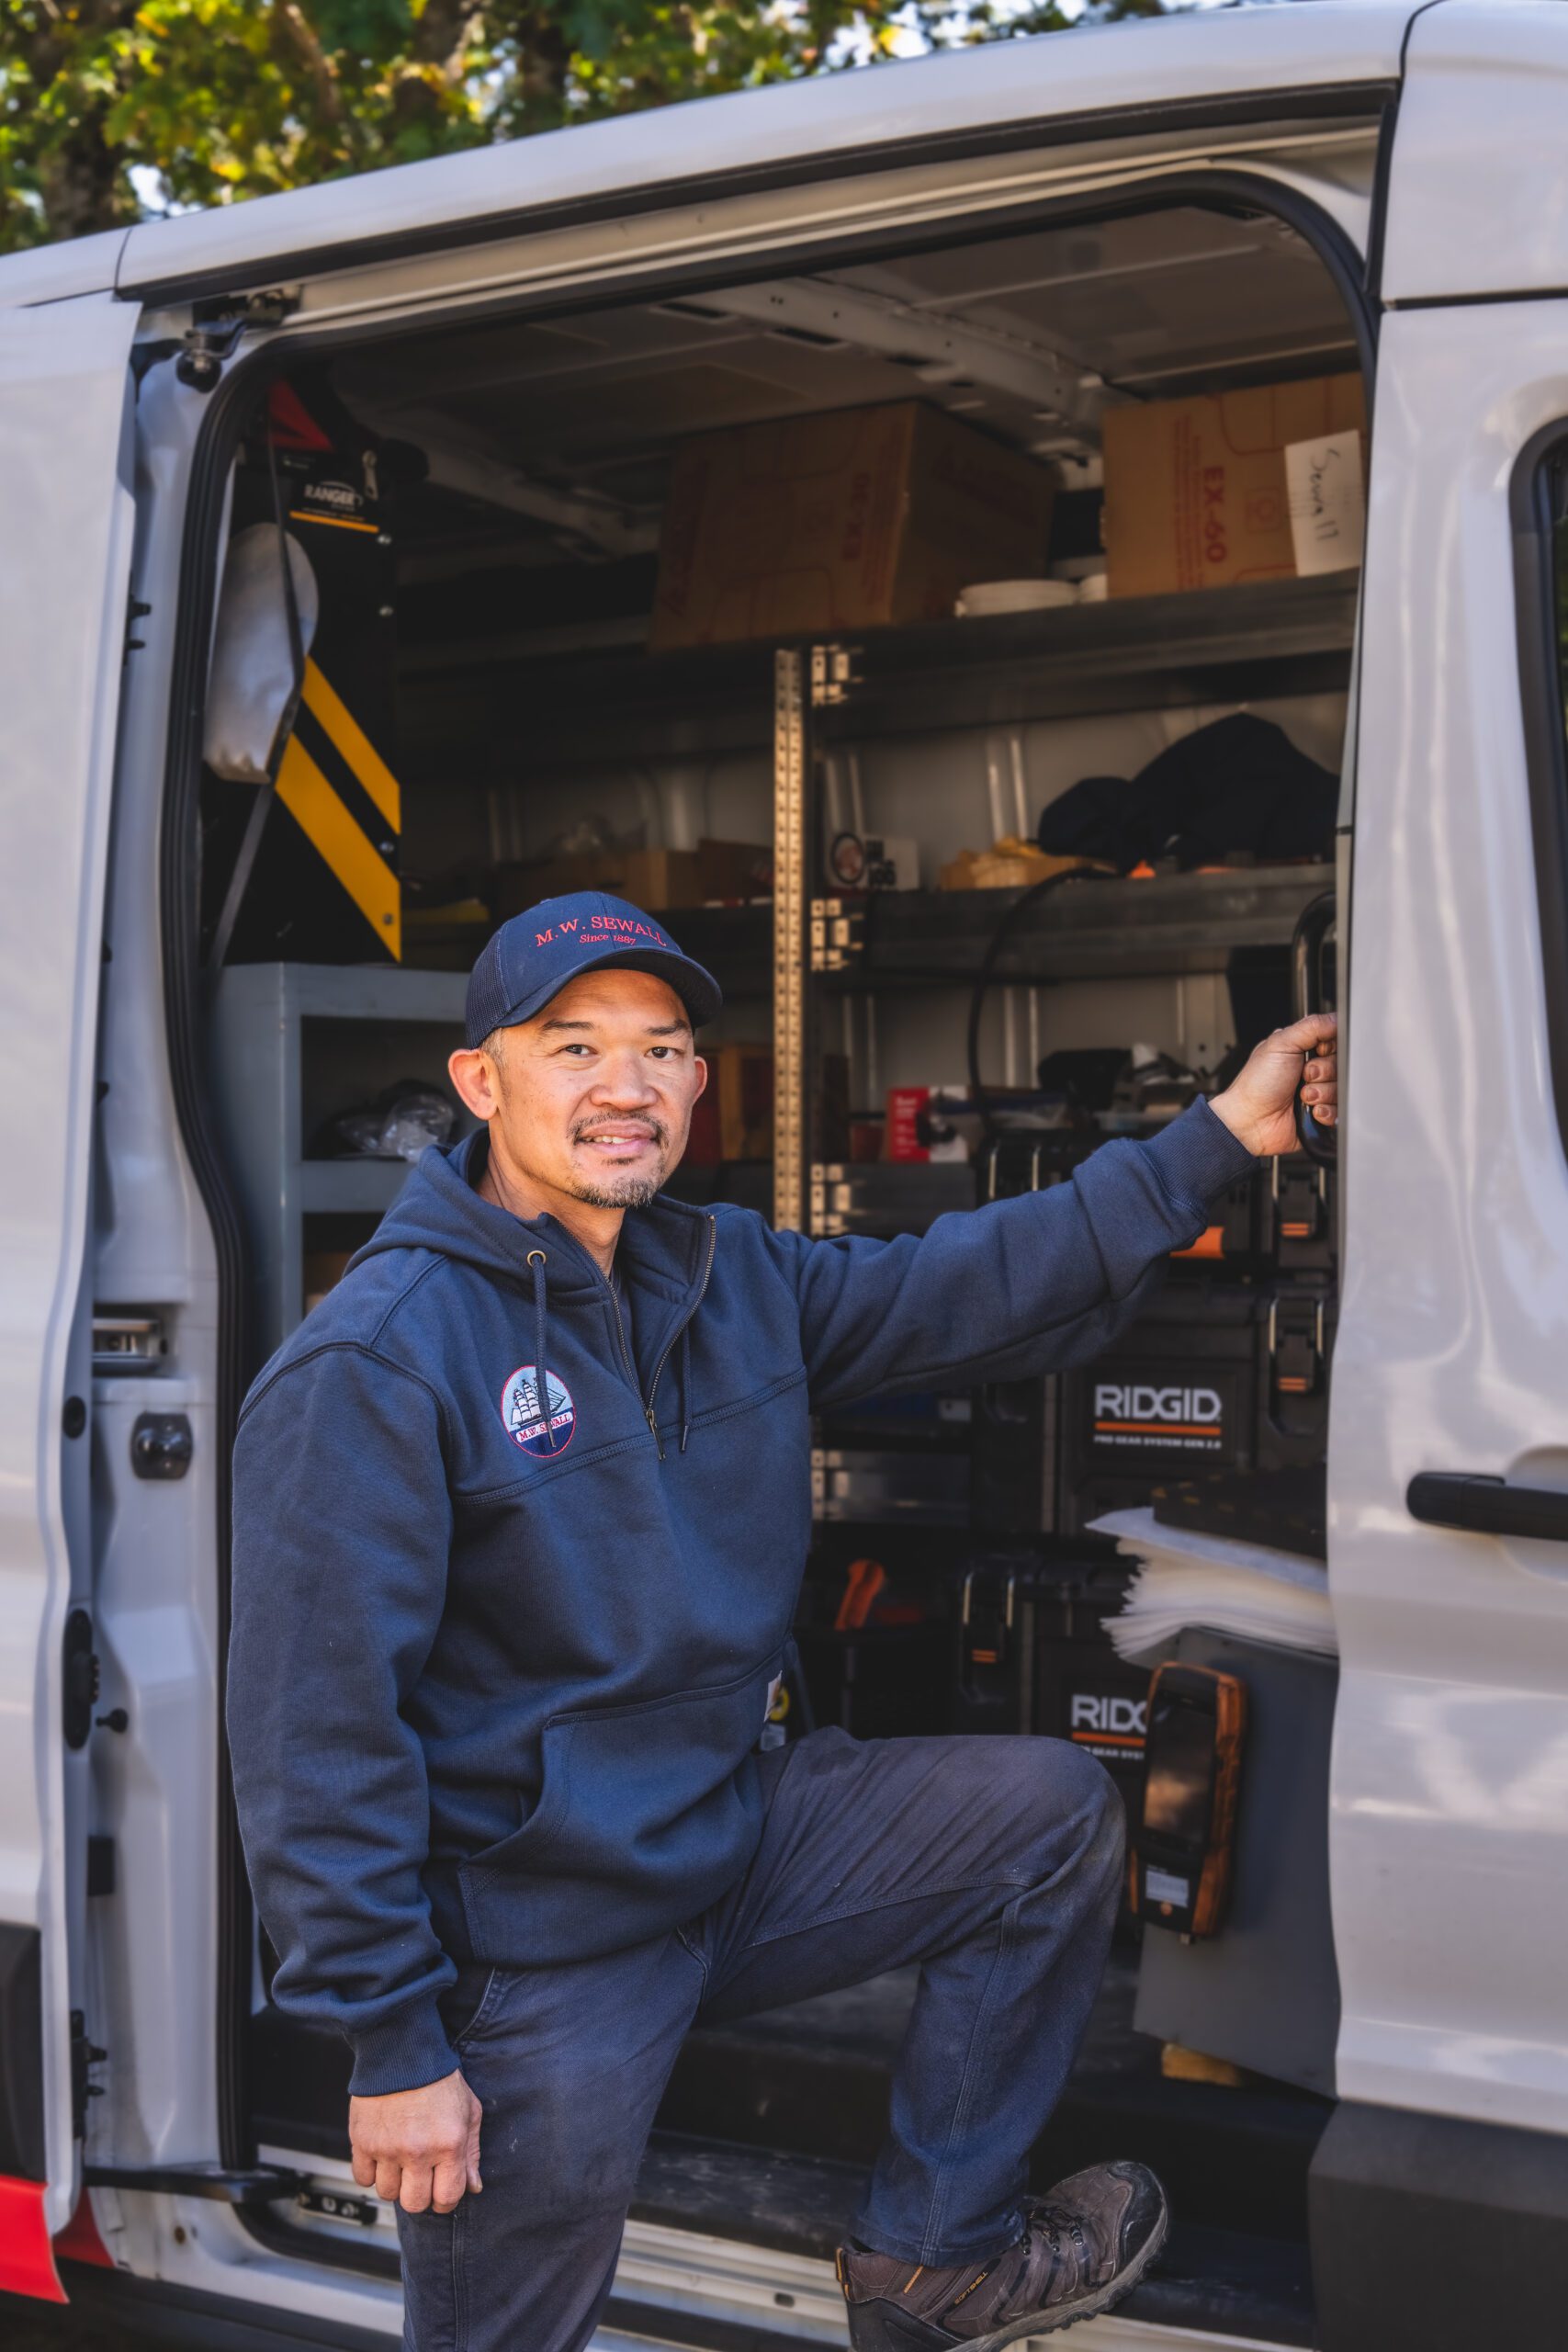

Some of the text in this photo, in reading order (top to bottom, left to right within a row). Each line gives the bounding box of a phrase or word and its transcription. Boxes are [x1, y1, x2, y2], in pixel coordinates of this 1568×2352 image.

[579, 933, 637, 945] Since 1887
[591, 916, 668, 947] SEWALL
[1094, 1385, 1223, 1422] RIDGID
[1115, 1435, 1142, 1445] GEAR
[1144, 1437, 1182, 1448] SYSTEM
